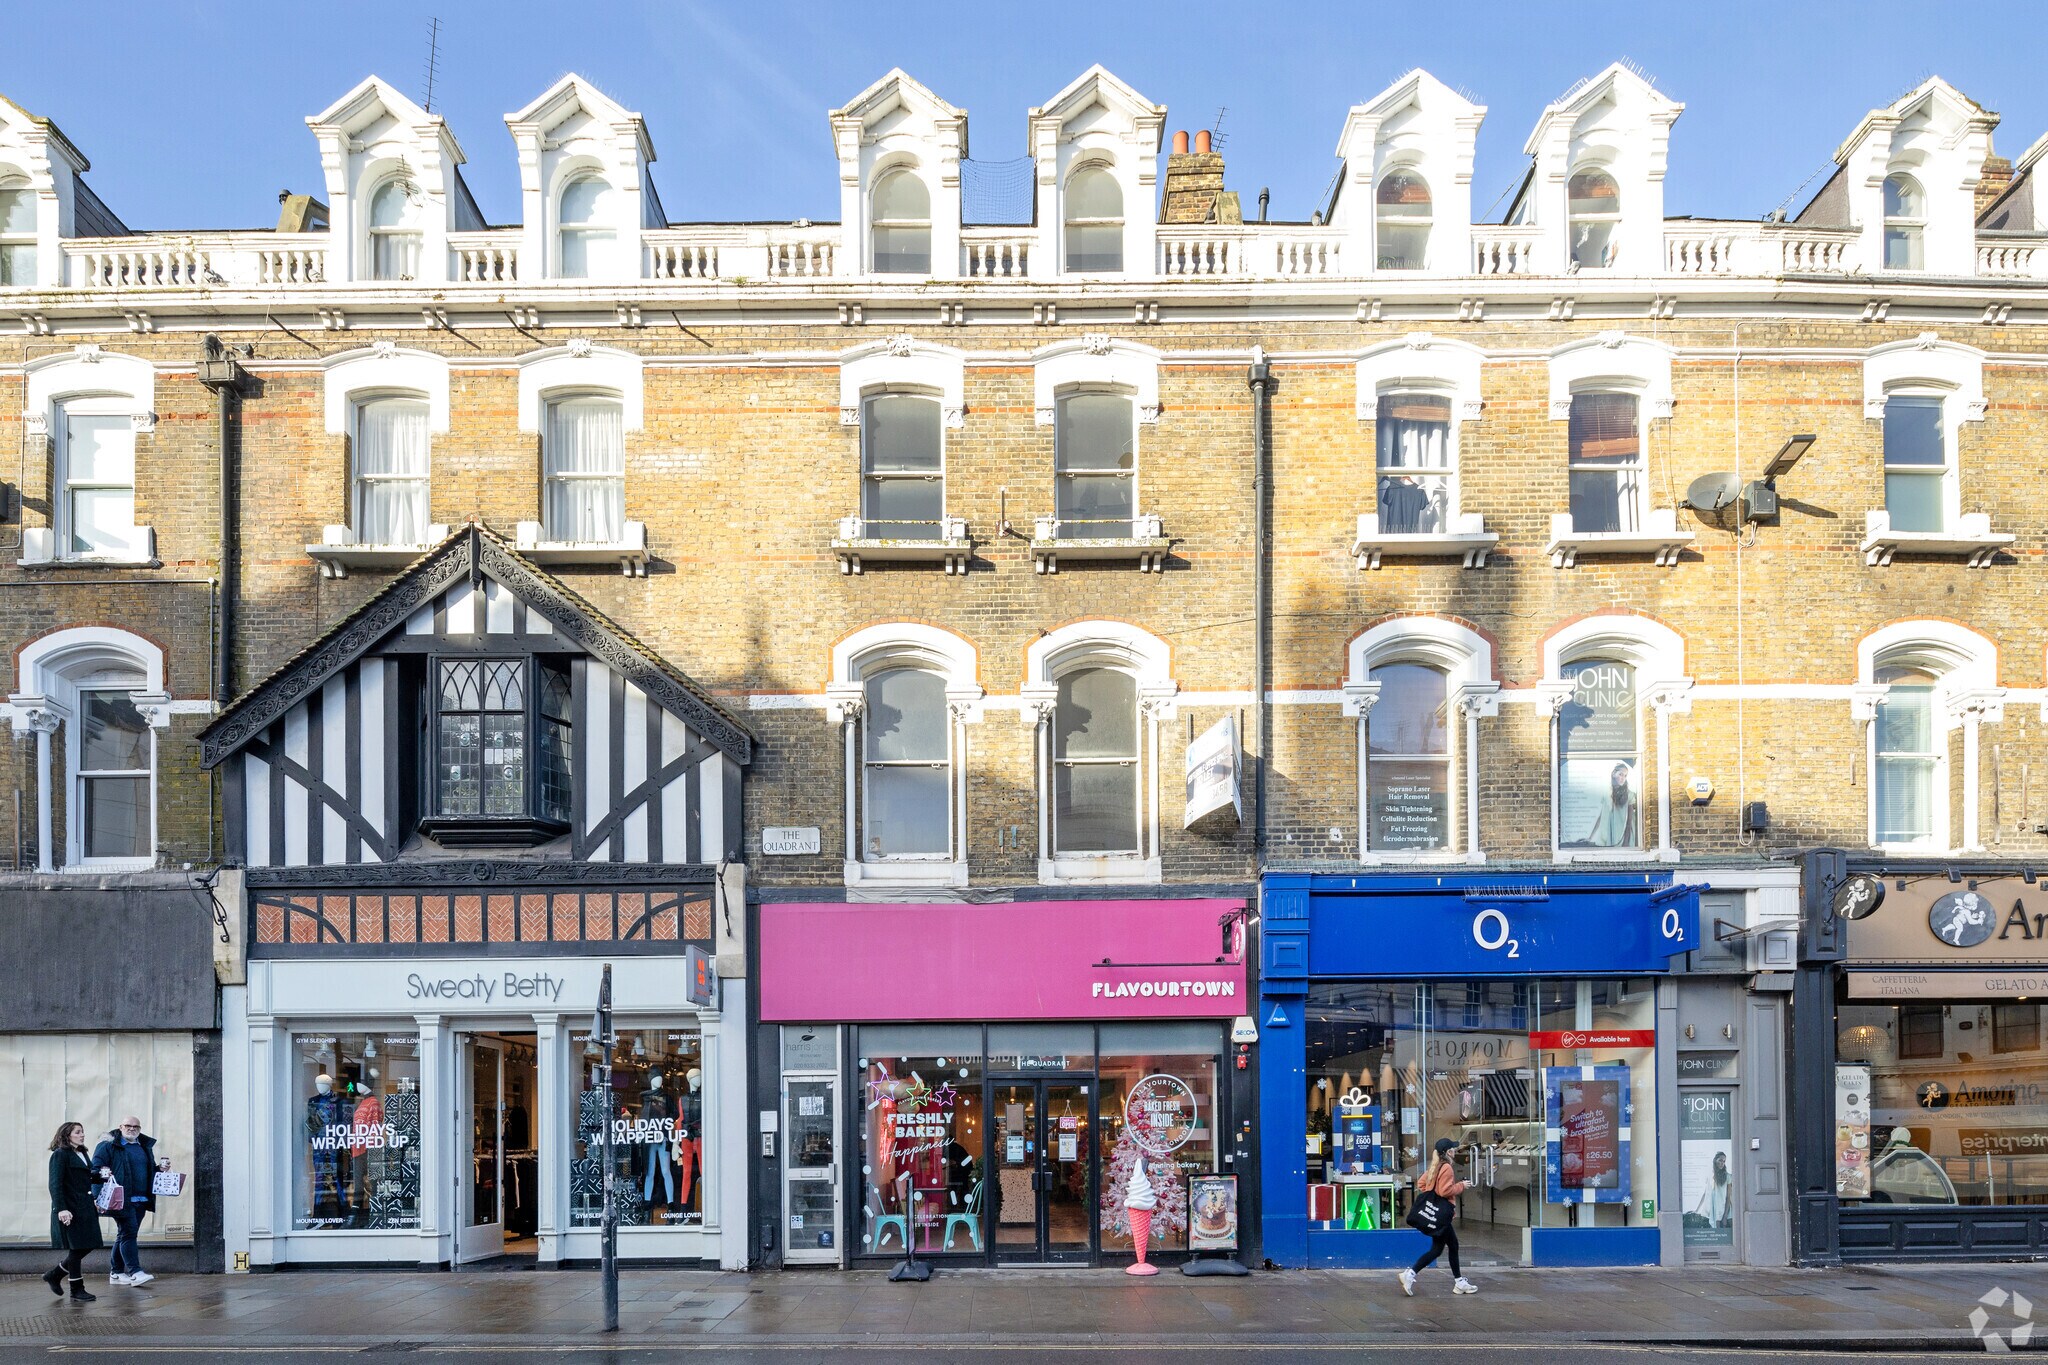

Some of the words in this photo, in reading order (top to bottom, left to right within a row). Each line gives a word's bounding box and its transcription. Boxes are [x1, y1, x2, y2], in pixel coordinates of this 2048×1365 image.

[1574, 691, 1629, 707] CLINIC
[782, 831, 800, 839] THE
[764, 842, 817, 851] QUADRANT
[1662, 909, 1685, 942] O2
[1472, 909, 1520, 958] O2
[1872, 975, 1928, 984] CAFFETTERIA
[1985, 979, 2038, 991] GELATO
[407, 972, 496, 1003] Sweaty
[504, 972, 564, 1002] Betty
[1092, 982, 1235, 998] FLAVOURTOWN
[1881, 987, 1920, 995] ITALIANA
[1683, 1060, 1704, 1070] JOHN
[1955, 1079, 2040, 1103] Amorino
[1163, 1101, 1181, 1111] FRESH
[1683, 1098, 1691, 1106] ST
[1691, 1098, 1725, 1113] JOHN
[887, 1113, 954, 1125] FRESHLY
[1151, 1114, 1174, 1128] INSIDE
[1570, 1110, 1594, 1123] Switch
[1596, 1109, 1603, 1117] to
[1575, 1116, 1605, 1129] ultrafast
[1691, 1111, 1726, 1122] CLINIC
[326, 1123, 395, 1137] HOLIDAYS
[669, 1130, 688, 1142] UP
[895, 1126, 946, 1138] BAKED
[1570, 1122, 1609, 1137] broadband
[312, 1136, 385, 1150] WRAPPED
[390, 1136, 409, 1148] UP
[882, 1129, 955, 1169] Happiness
[1586, 1151, 1613, 1159] £26.50
